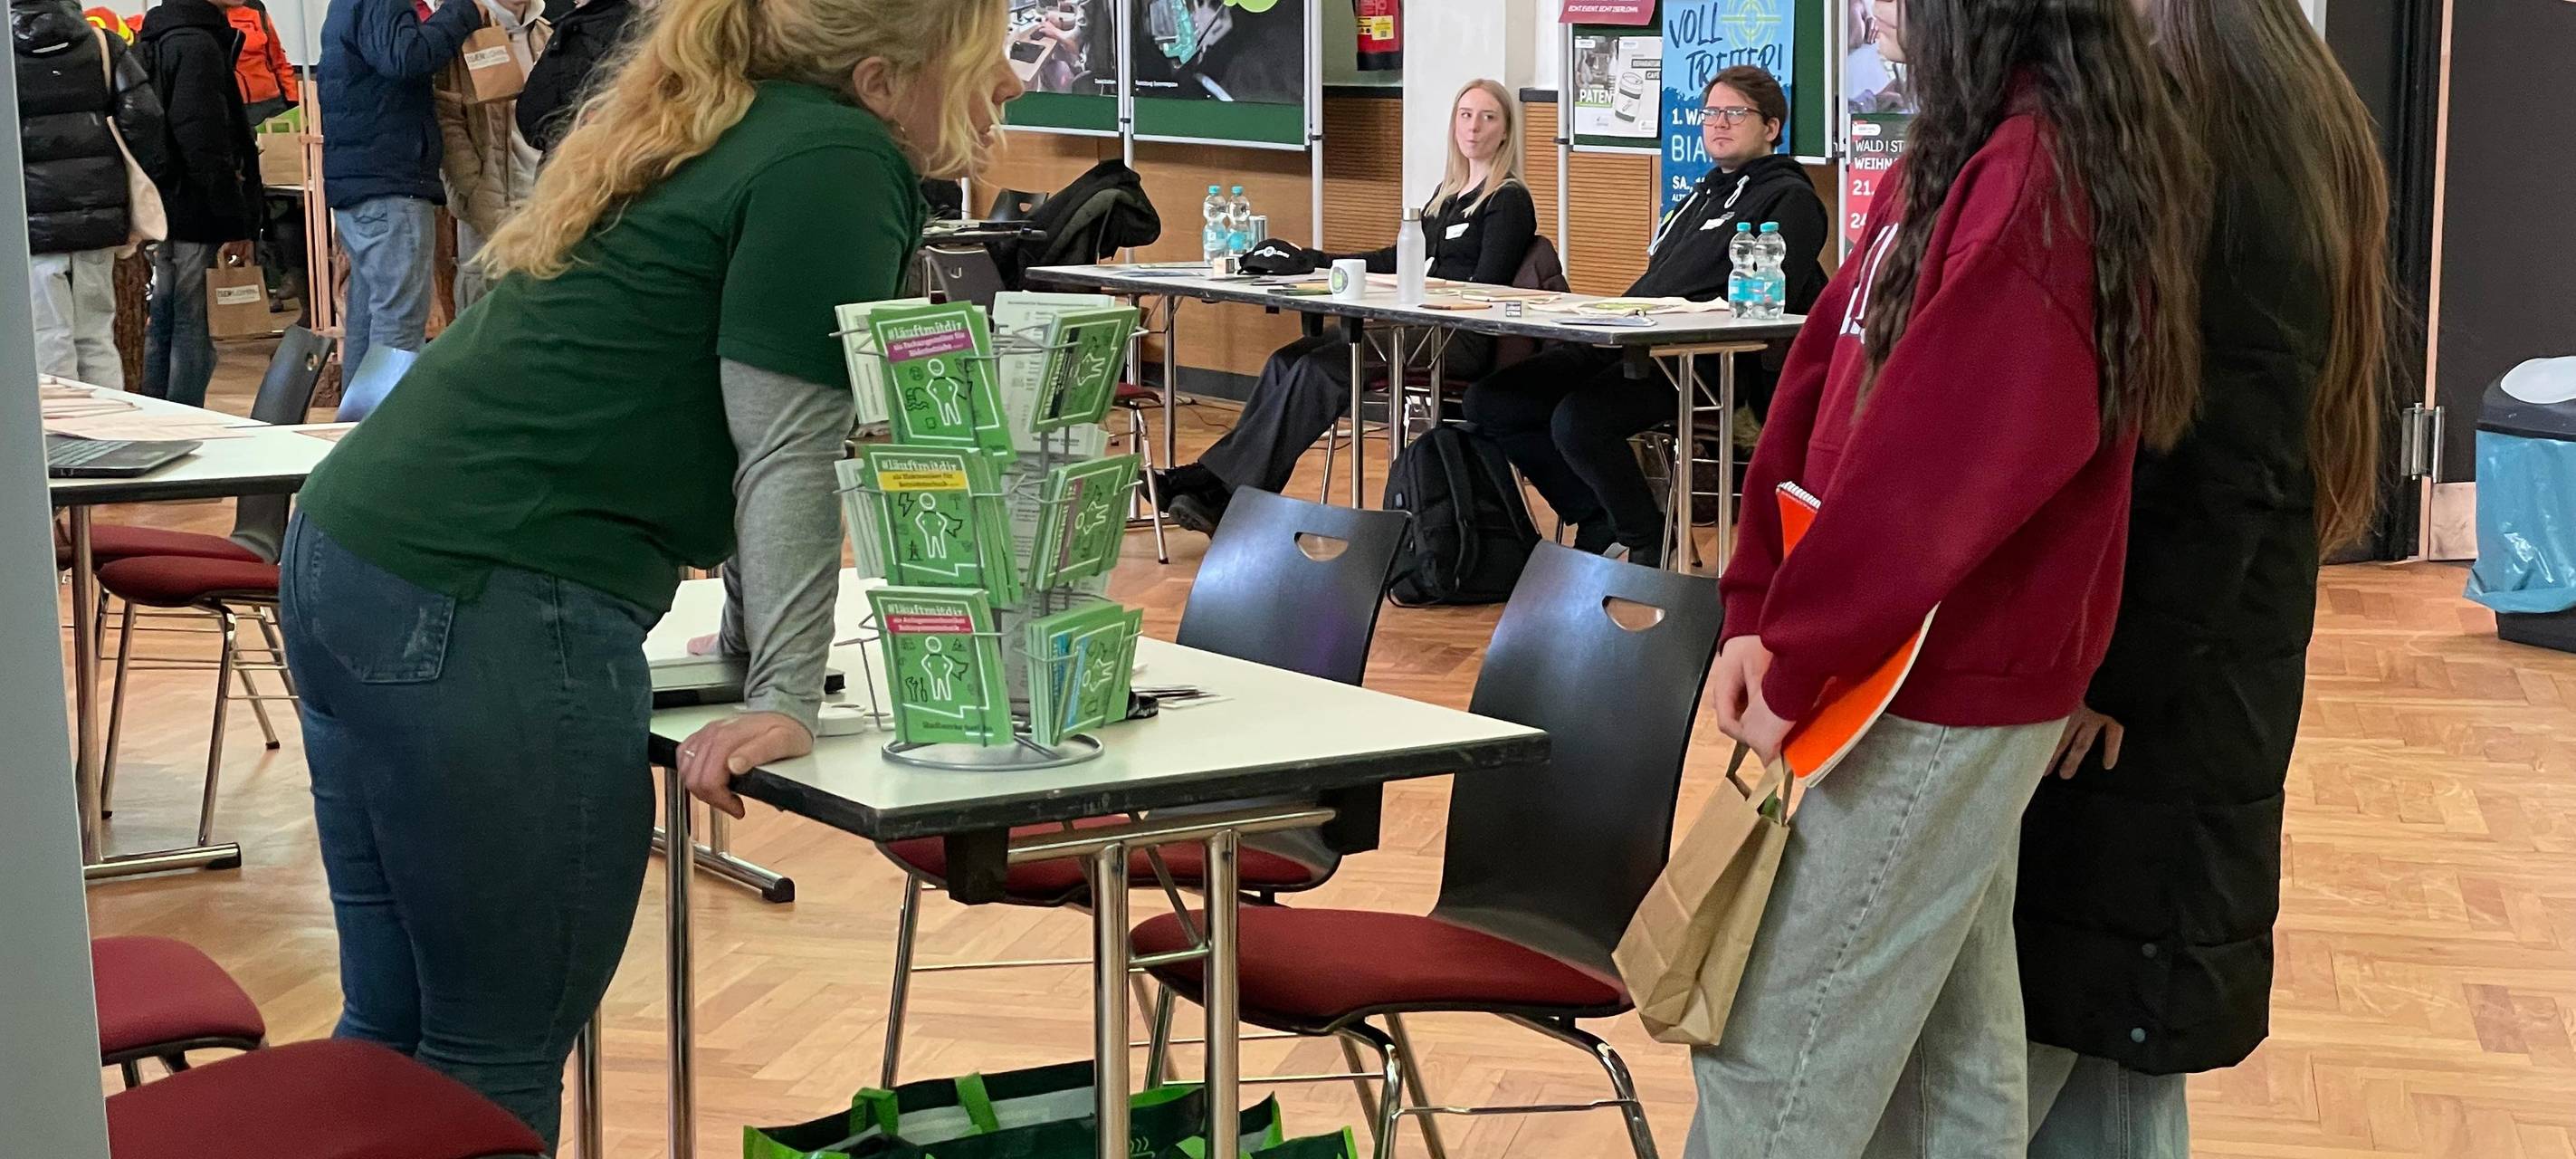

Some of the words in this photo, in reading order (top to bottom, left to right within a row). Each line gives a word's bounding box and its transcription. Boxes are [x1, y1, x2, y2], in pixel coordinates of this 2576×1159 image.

[1668, 2, 1723, 49] VOLL
[1672, 108, 1684, 125] 1.
[1672, 135, 1713, 163] BIA
[1856, 139, 1884, 152] WALD
[1854, 157, 1899, 170] WEIHN
[887, 320, 962, 340] #läuftmitdir
[881, 458, 958, 472] #läuftmitdir
[887, 603, 964, 616] #läuftmitdir
